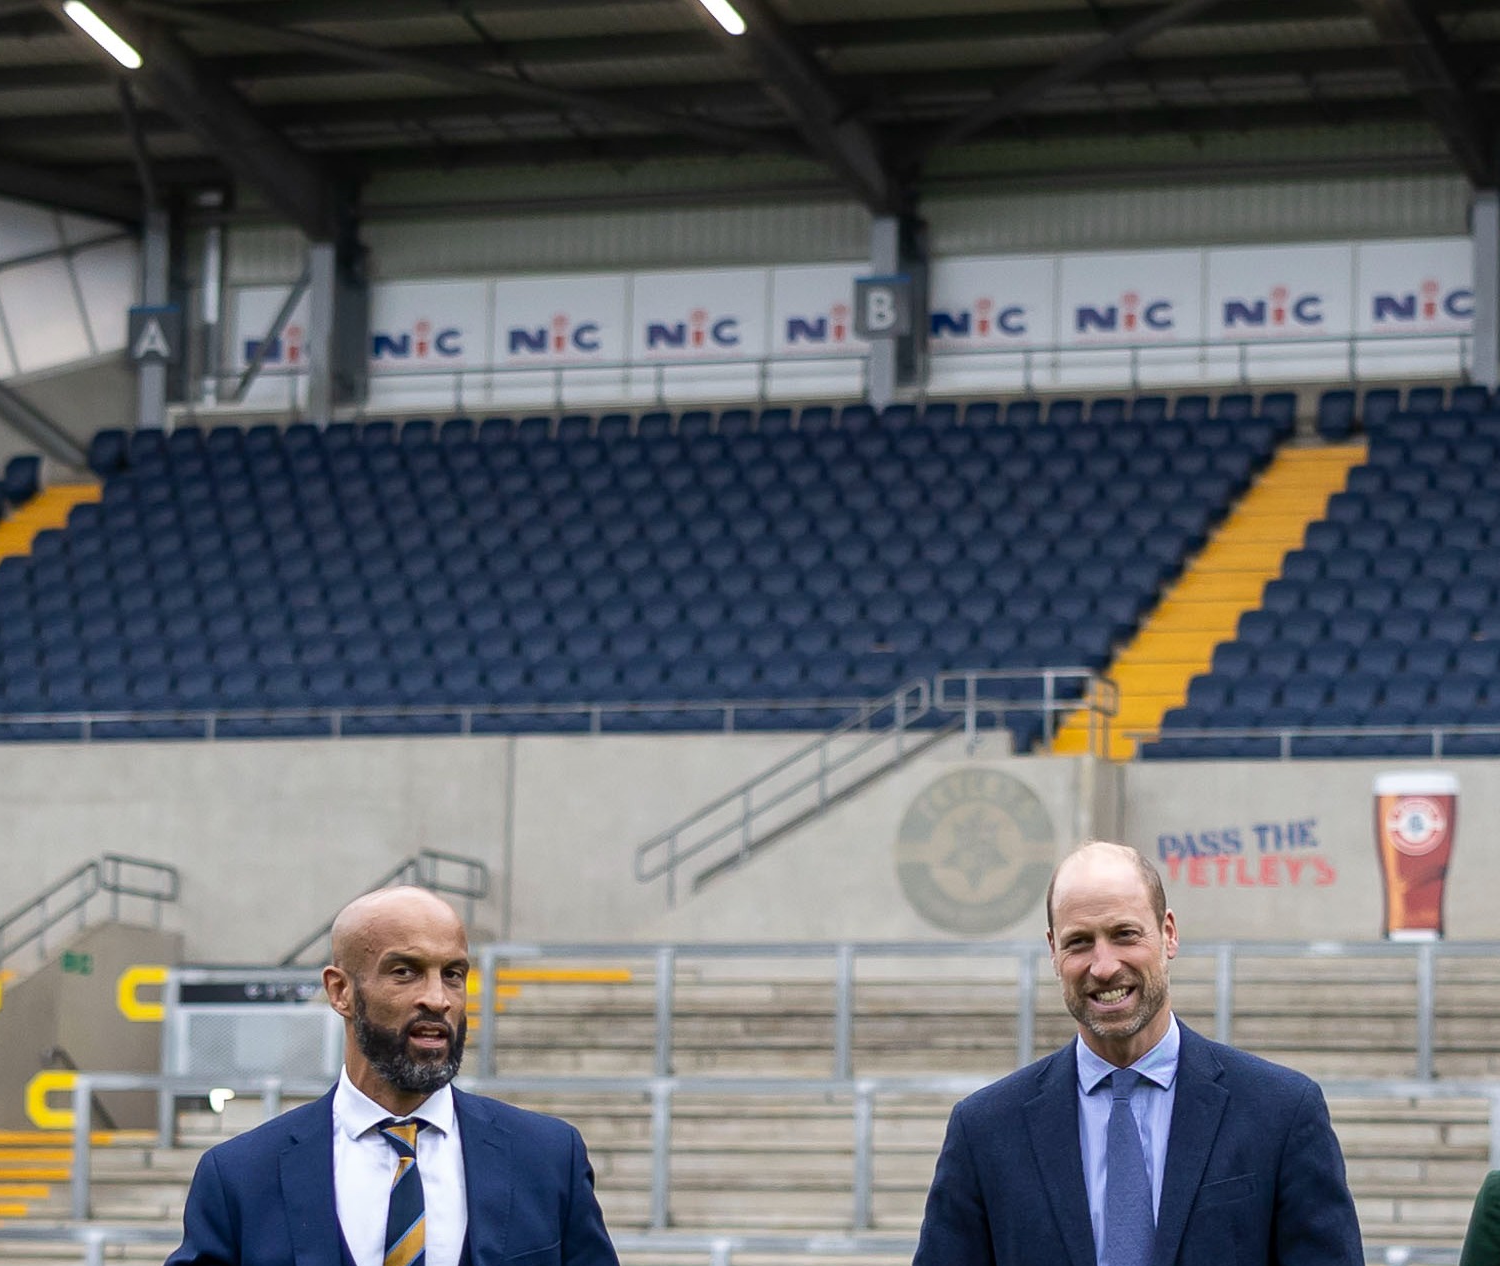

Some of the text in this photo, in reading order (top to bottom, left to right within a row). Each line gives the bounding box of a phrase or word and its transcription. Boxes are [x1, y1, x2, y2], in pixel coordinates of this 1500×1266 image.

[787, 304, 849, 343] Ni
[866, 289, 897, 331] B
[133, 316, 171, 359] A
[245, 326, 312, 363] Ni
[1158, 816, 1319, 863] PASS THE
